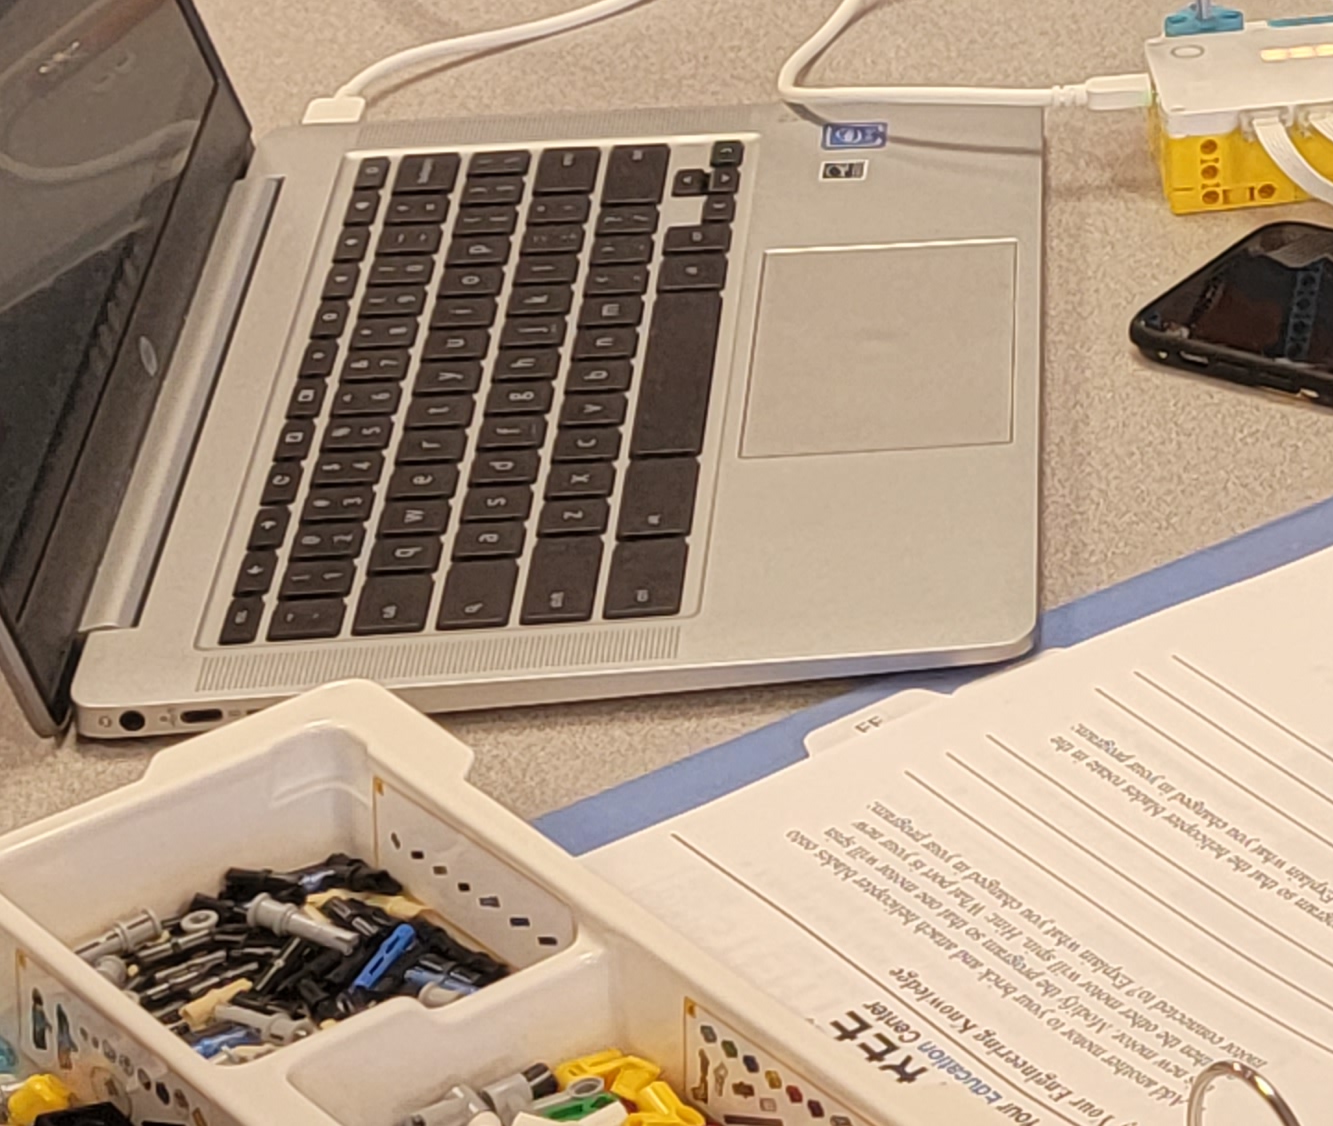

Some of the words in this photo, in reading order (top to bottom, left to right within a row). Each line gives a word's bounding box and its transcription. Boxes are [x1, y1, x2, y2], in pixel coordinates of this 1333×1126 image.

[1050, 736, 1075, 752] the
[1085, 760, 1127, 787] rotate
[1125, 762, 1166, 785] your
[1121, 785, 1167, 817] blades
[1167, 792, 1228, 829] changed
[824, 827, 856, 848] spin
[851, 822, 885, 840] new
[1161, 813, 1231, 859] helicopter
[1225, 827, 1260, 848] you
[845, 846, 879, 866] will
[878, 839, 920, 861] your
[921, 841, 962, 863] your
[1249, 844, 1287, 869] what
[813, 850, 859, 881] blades
[1226, 855, 1253, 872] the
[874, 864, 919, 893] motor
[919, 868, 960, 889] port
[961, 872, 1023, 909] changed
[1247, 870, 1279, 890] that
[852, 877, 921, 926] helicopter
[913, 892, 943, 910] one
[946, 887, 986, 917] What
[935, 909, 969, 930] that
[1019, 908, 1056, 929] you
[913, 921, 958, 950] attach
[1043, 926, 1080, 952] what
[948, 950, 984, 969] and
[981, 939, 1046, 981] program
[1046, 961, 1081, 982] will
[1078, 950, 1135, 990] Explain
[977, 968, 1018, 998] brick
[1035, 979, 1062, 998] the
[1077, 981, 1125, 1010] motor
[889, 968, 976, 1034] Knowledge
[1012, 994, 1056, 1019] your
[862, 1001, 921, 1043] Center
[1056, 996, 1114, 1034] Modify
[1118, 1008, 1159, 1032] other
[1147, 1000, 1225, 1045] connected
[1060, 1029, 1108, 1057] motor
[1155, 1031, 1182, 1048] the
[972, 1029, 1074, 1102] Engineering
[1152, 1059, 1189, 1078] new
[1219, 1042, 1264, 1070] motor
[1101, 1055, 1158, 1088] another
[1068, 1098, 1115, 1126] Your
